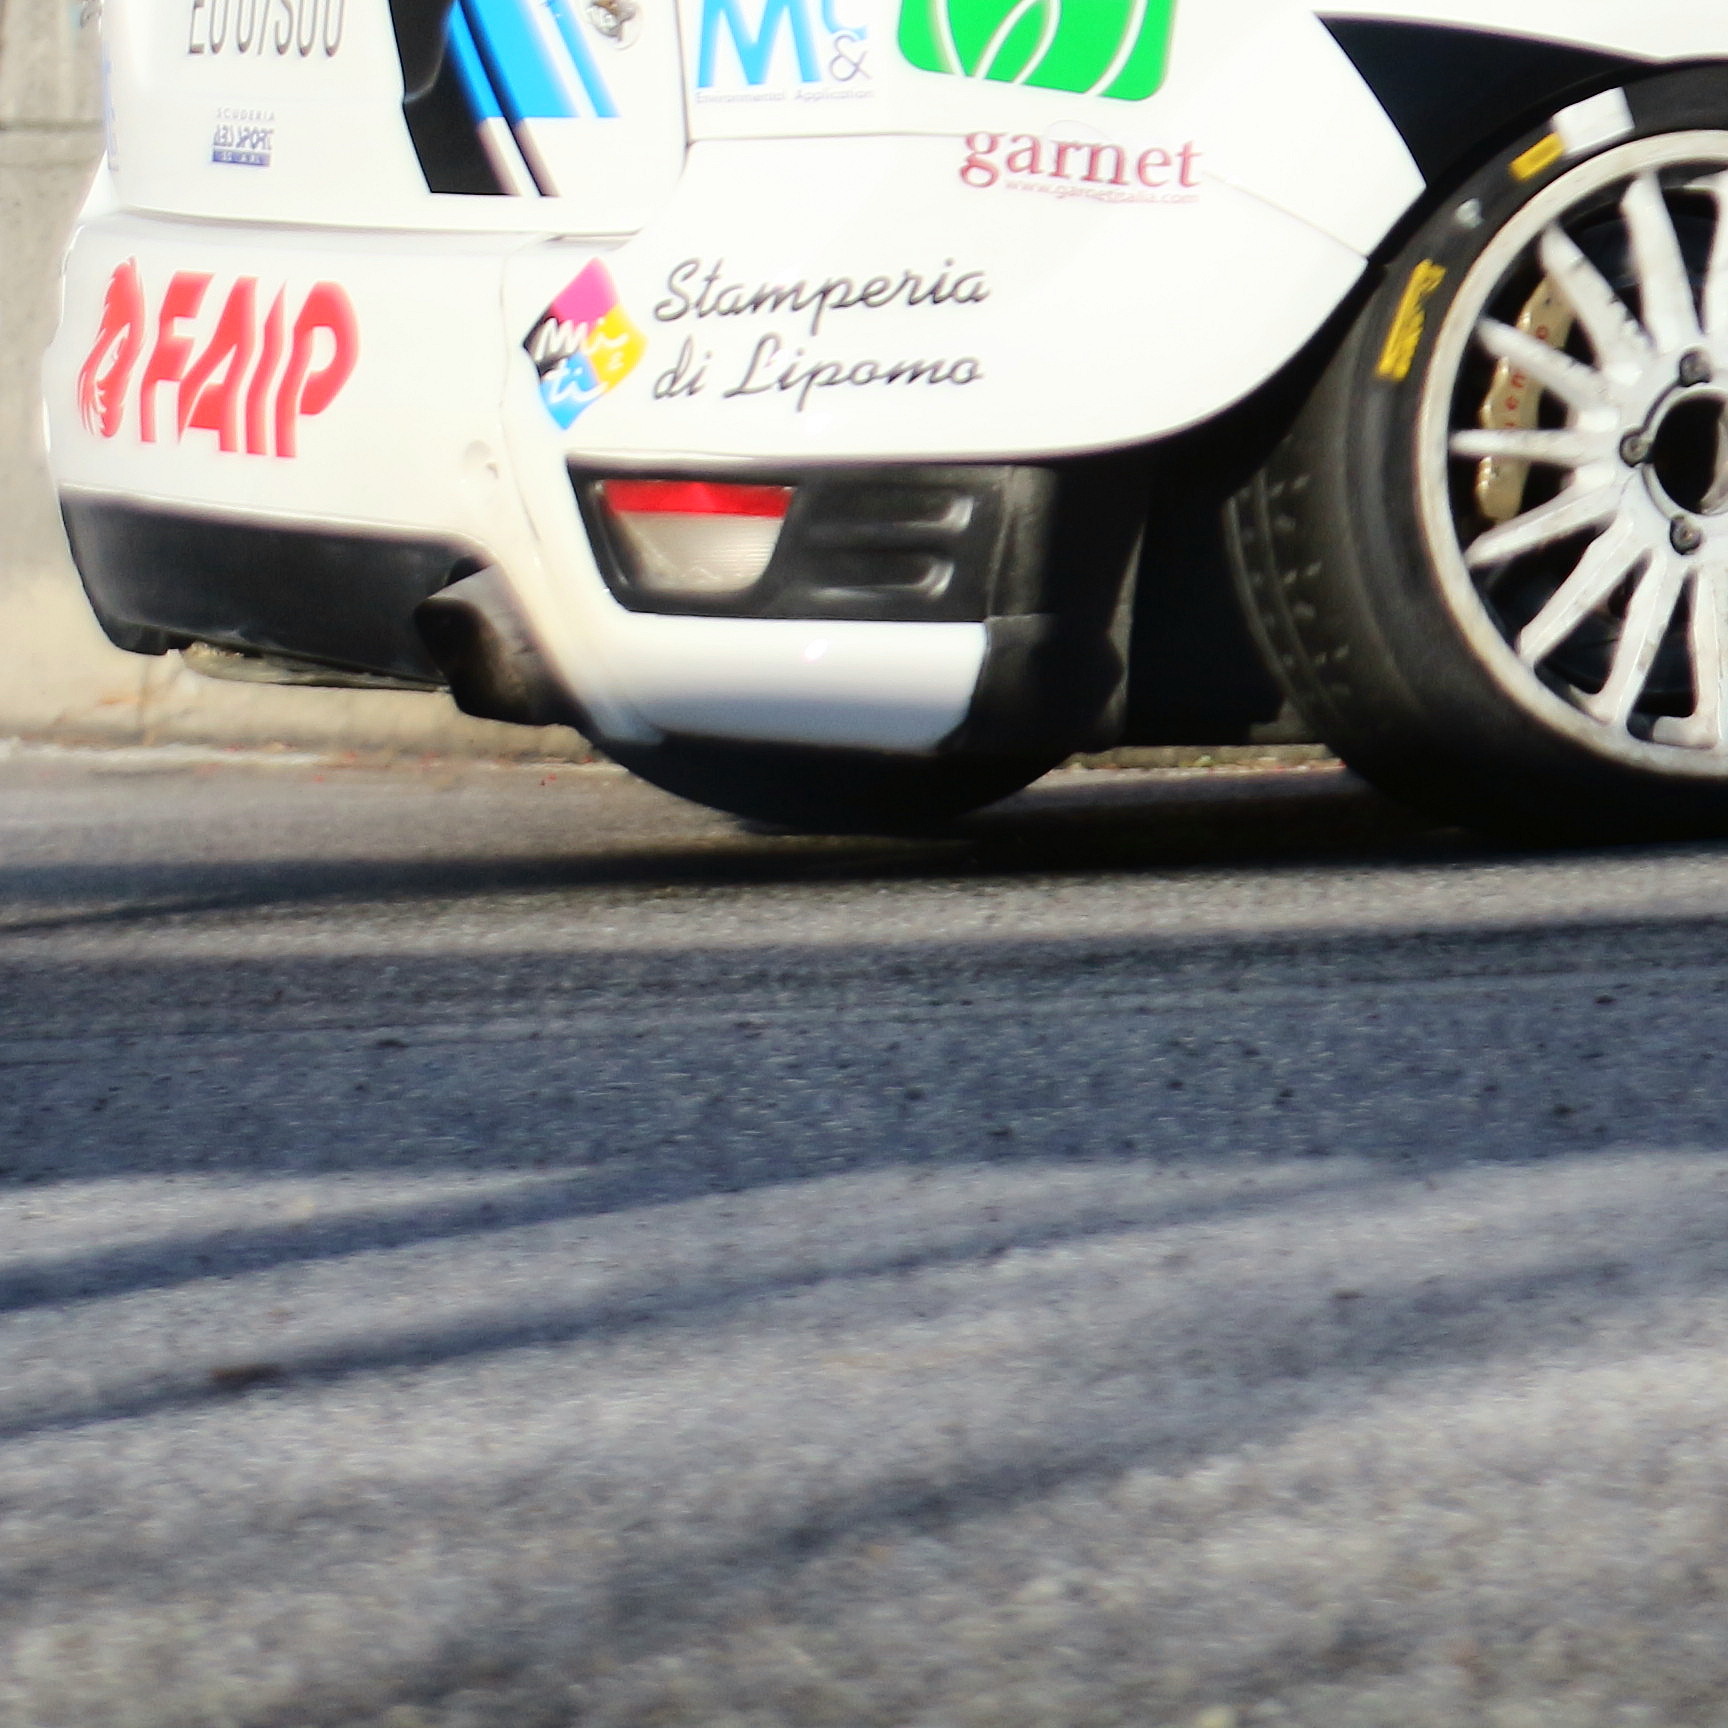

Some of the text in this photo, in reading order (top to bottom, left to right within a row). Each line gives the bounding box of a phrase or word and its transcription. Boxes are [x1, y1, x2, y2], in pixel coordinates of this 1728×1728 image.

[959, 131, 1203, 188] garnet
[654, 258, 991, 336] Stamperia
[141, 270, 360, 458] FAIP
[654, 332, 984, 413] di Lipomo
